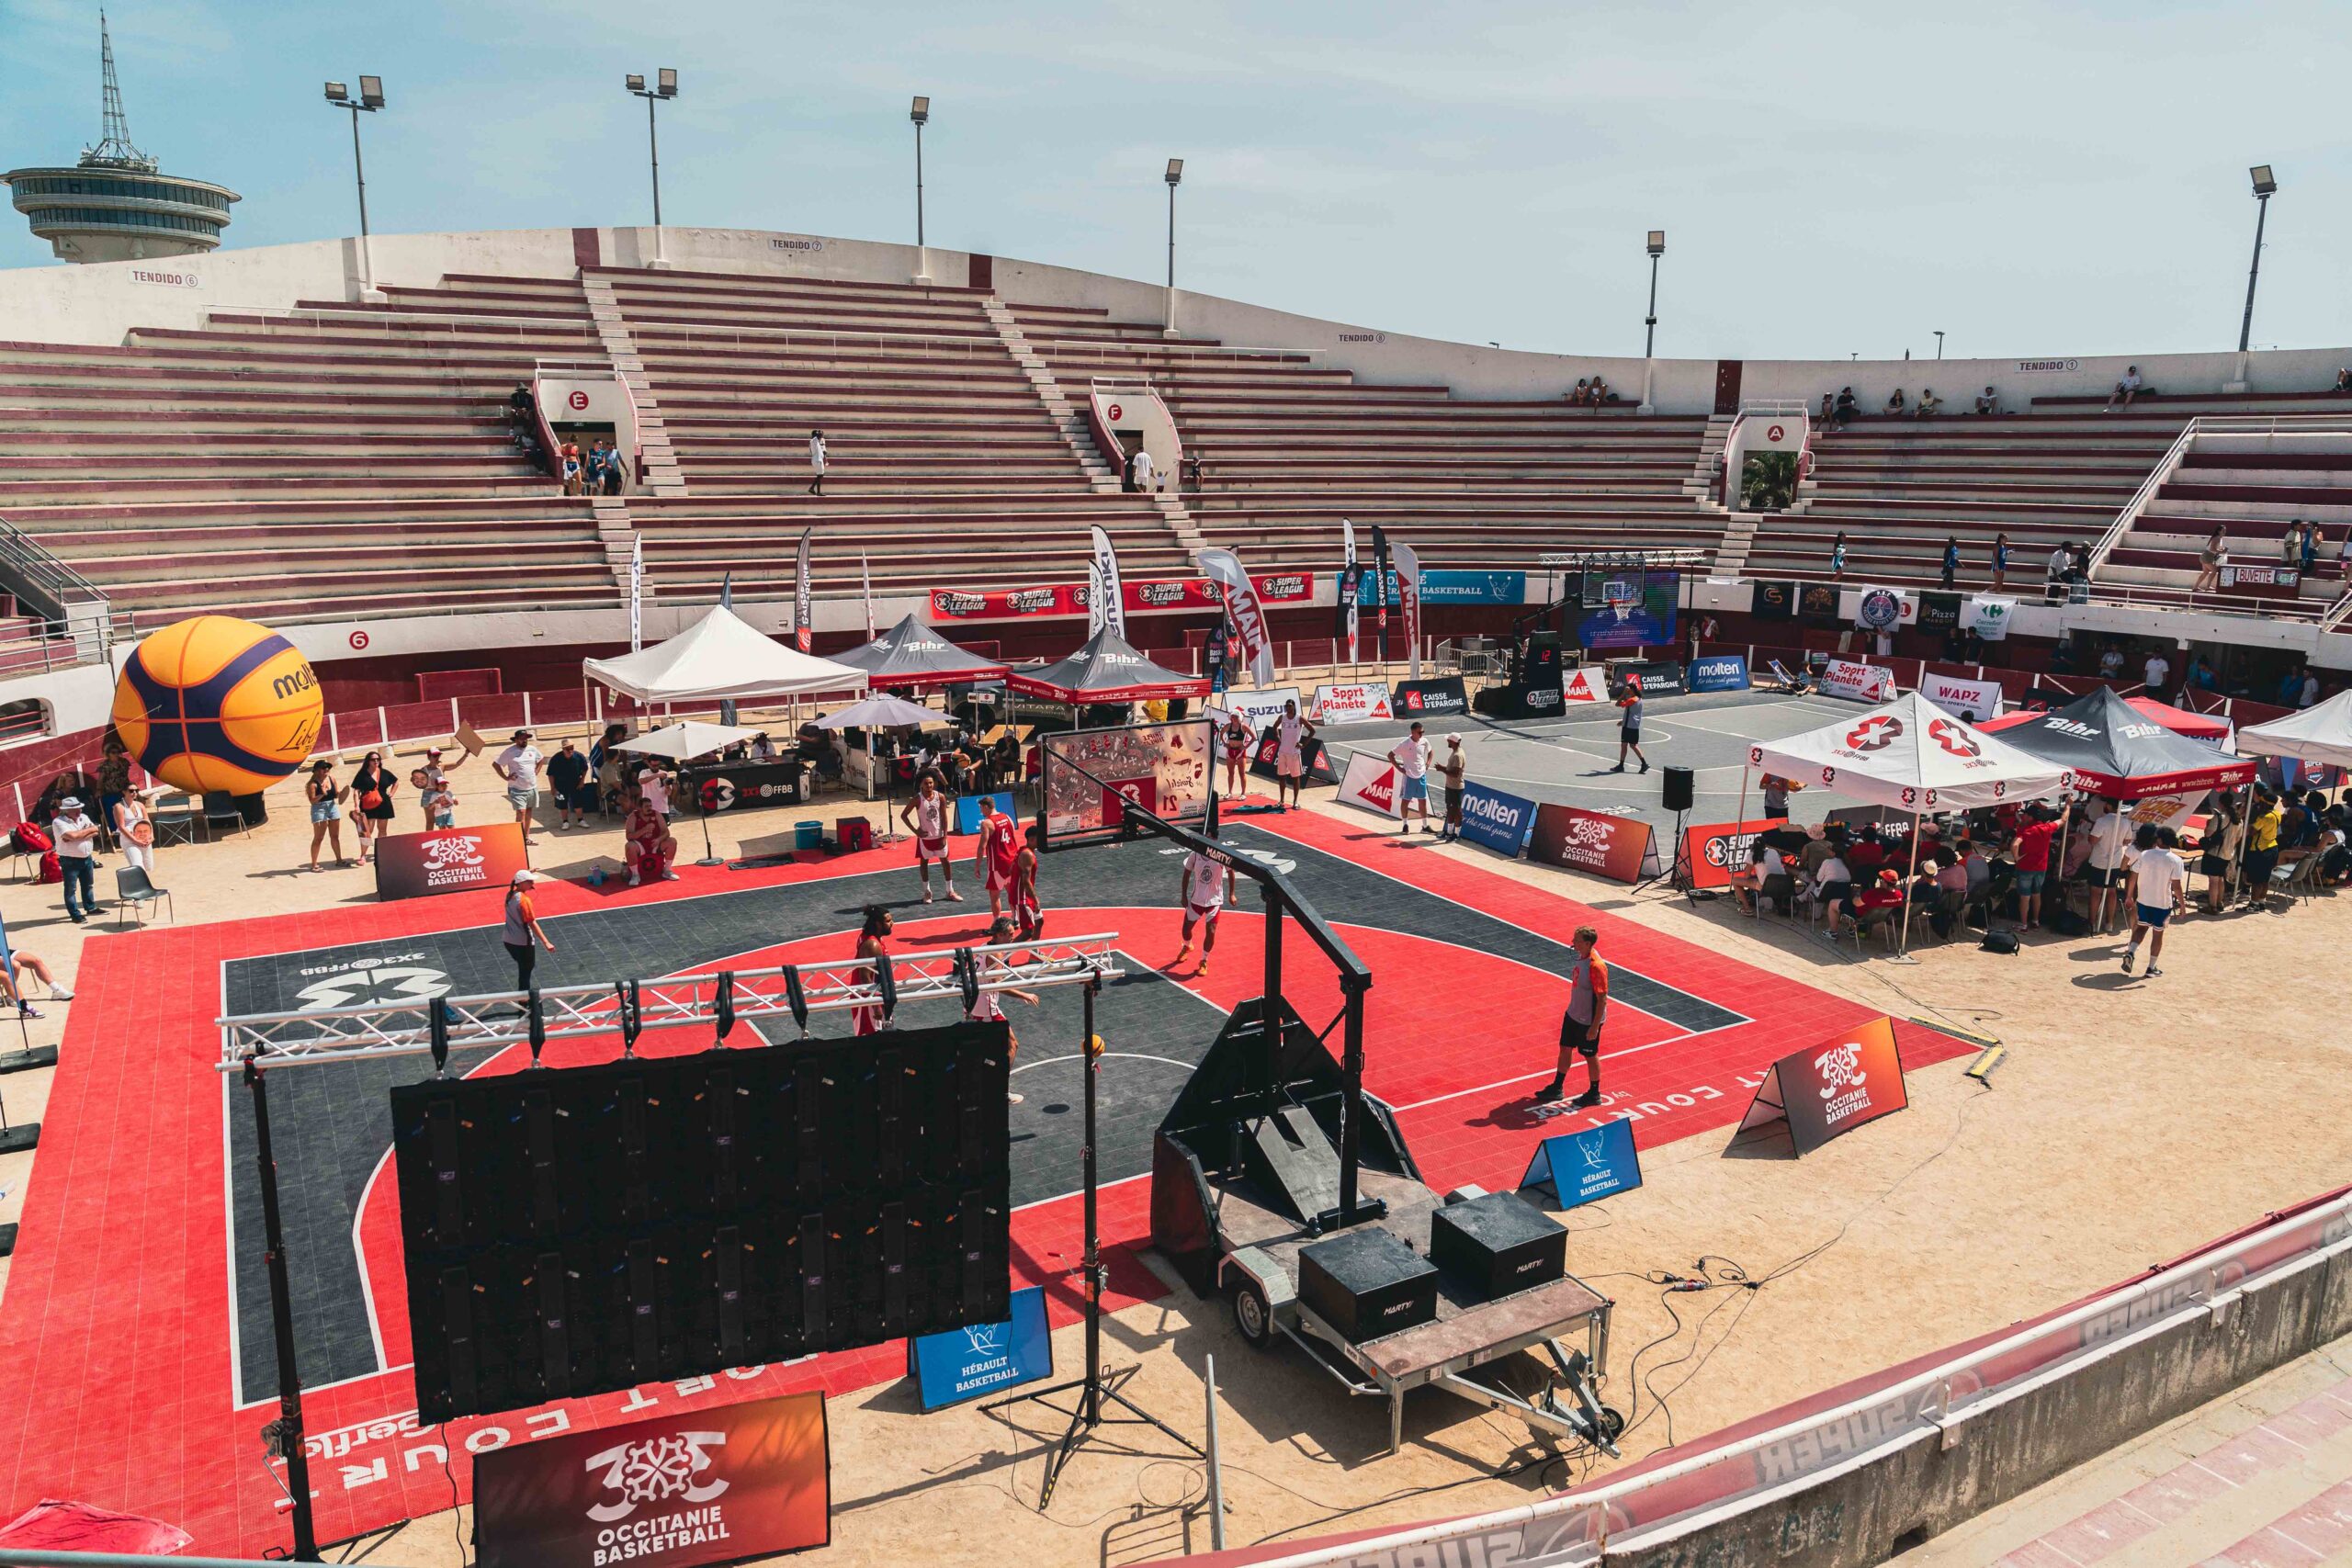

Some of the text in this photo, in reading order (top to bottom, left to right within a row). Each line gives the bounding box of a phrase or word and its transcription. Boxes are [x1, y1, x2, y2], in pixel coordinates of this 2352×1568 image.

[773, 240, 810, 250] TENDIDO
[132, 270, 183, 285] TENDIDO
[2019, 361, 2064, 371] TENDIDO
[572, 392, 585, 407] E
[1110, 407, 1119, 418] F
[1770, 427, 1781, 439] A
[1276, 577, 1303, 586] SUPER
[2239, 569, 2272, 582] BUVETTE
[1154, 582, 1182, 592] SUPER
[1274, 585, 1305, 594] LEAGUE
[1422, 586, 1483, 596] BASKETBALL
[952, 593, 984, 602] SUPER
[1023, 589, 1052, 599] SUPER
[1153, 592, 1185, 601] LEAGUE
[950, 601, 987, 611] LEAGUE
[1021, 596, 1055, 608] LEAGUE
[1931, 607, 1956, 618] Pizza
[1226, 589, 1261, 654] MAIF
[352, 633, 366, 647] 6
[902, 637, 945, 652] Bihr
[1099, 650, 1139, 663] Bihr
[1699, 662, 1739, 676] molten
[1838, 662, 1866, 677] Sport
[1642, 675, 1665, 683] CAISSE
[1643, 681, 1679, 690] D'EPARGNE
[1332, 687, 1365, 702] Sport
[1422, 693, 1448, 701] CAISSE
[1566, 686, 1589, 696] MAIF
[1863, 689, 1879, 697] MAIF
[1939, 685, 1980, 703] WAPZ
[1322, 698, 1366, 710] Planète
[1424, 698, 1464, 709] D'EPARGNE
[1536, 695, 1559, 705] LEAGUE
[1013, 704, 1066, 712] VITARA
[1248, 705, 1288, 716] SUZU
[1373, 707, 1388, 716] MAIF
[2043, 717, 2102, 737] Bihr
[2116, 722, 2163, 739] Bihr
[2219, 770, 2244, 783] Bihr
[741, 784, 793, 796] 3X3 FFBB
[1365, 782, 1394, 801] MAIF
[1462, 794, 1520, 828] molten
[1001, 829, 1011, 844] 4
[1477, 820, 1492, 834] real
[1492, 826, 1513, 840] game
[1562, 852, 1606, 867] BASKETBALL
[1565, 845, 1606, 861] OCCITANIE
[427, 872, 487, 886] BASKETBALL
[428, 865, 483, 880] OCCITANIE
[300, 953, 426, 976] 3X3 FFBB
[1826, 1086, 1868, 1114] OCCITANIE
[1826, 1096, 1872, 1125] BASKETBALL
[1581, 1168, 1611, 1185] HÉRAULT
[1579, 1179, 1620, 1197] BASKETBALL
[962, 1356, 1008, 1377] HÉRAULT
[956, 1367, 1019, 1393] BASKETBALL
[597, 1505, 723, 1548] OCCITANIE
[593, 1521, 730, 1567] BASKETBALL
